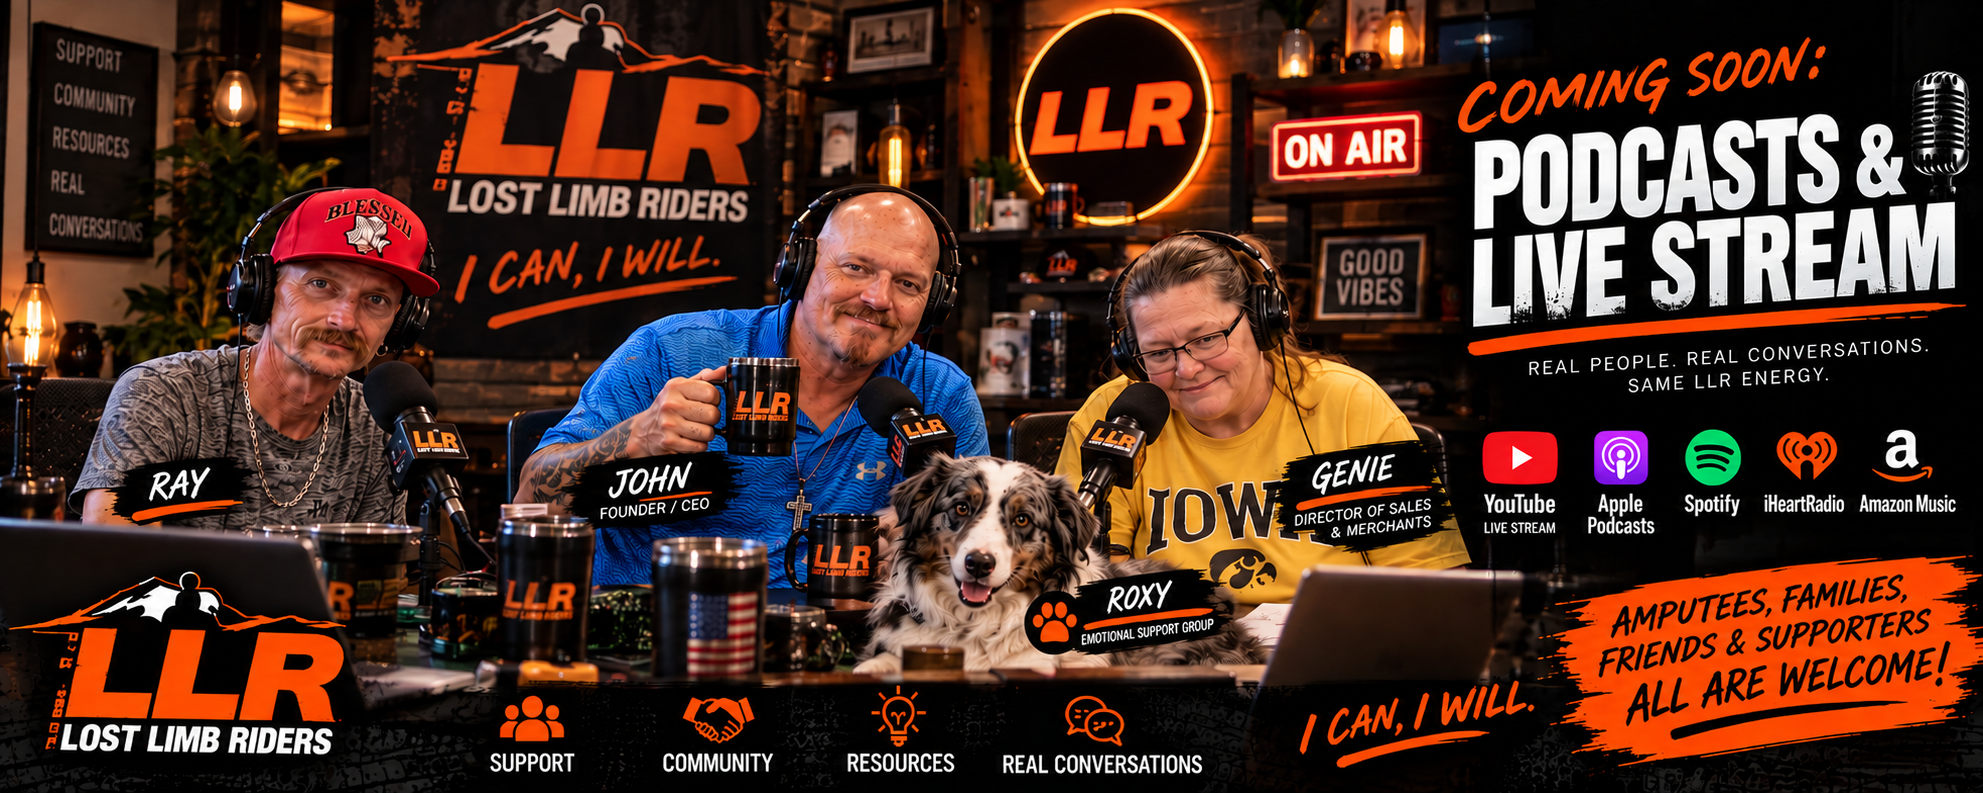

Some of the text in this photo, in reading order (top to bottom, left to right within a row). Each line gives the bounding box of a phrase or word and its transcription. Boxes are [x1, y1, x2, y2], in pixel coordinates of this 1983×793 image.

[56, 38, 122, 72] SUPPORT
[54, 83, 135, 117] COMMUNITY
[454, 63, 763, 185] LLR
[1028, 80, 1193, 156] LLR
[53, 126, 130, 159] RESOURCES
[1284, 128, 1407, 169] ON AIR
[51, 170, 85, 195] REAL
[448, 180, 747, 222] LOST LIMB RIDERS
[49, 213, 143, 243] CONVERSATIONS
[454, 235, 720, 303] I CAN, I WILL.
[1339, 249, 1404, 276] GOOD
[1336, 277, 1403, 305] VIBES
[739, 390, 791, 415] LLR
[412, 430, 460, 449] LLR
[902, 418, 946, 437] LLR
[1090, 427, 1137, 449] LLR
[1146, 480, 1335, 556] IOW
[813, 543, 872, 570] LLR
[504, 579, 576, 611] LLR
